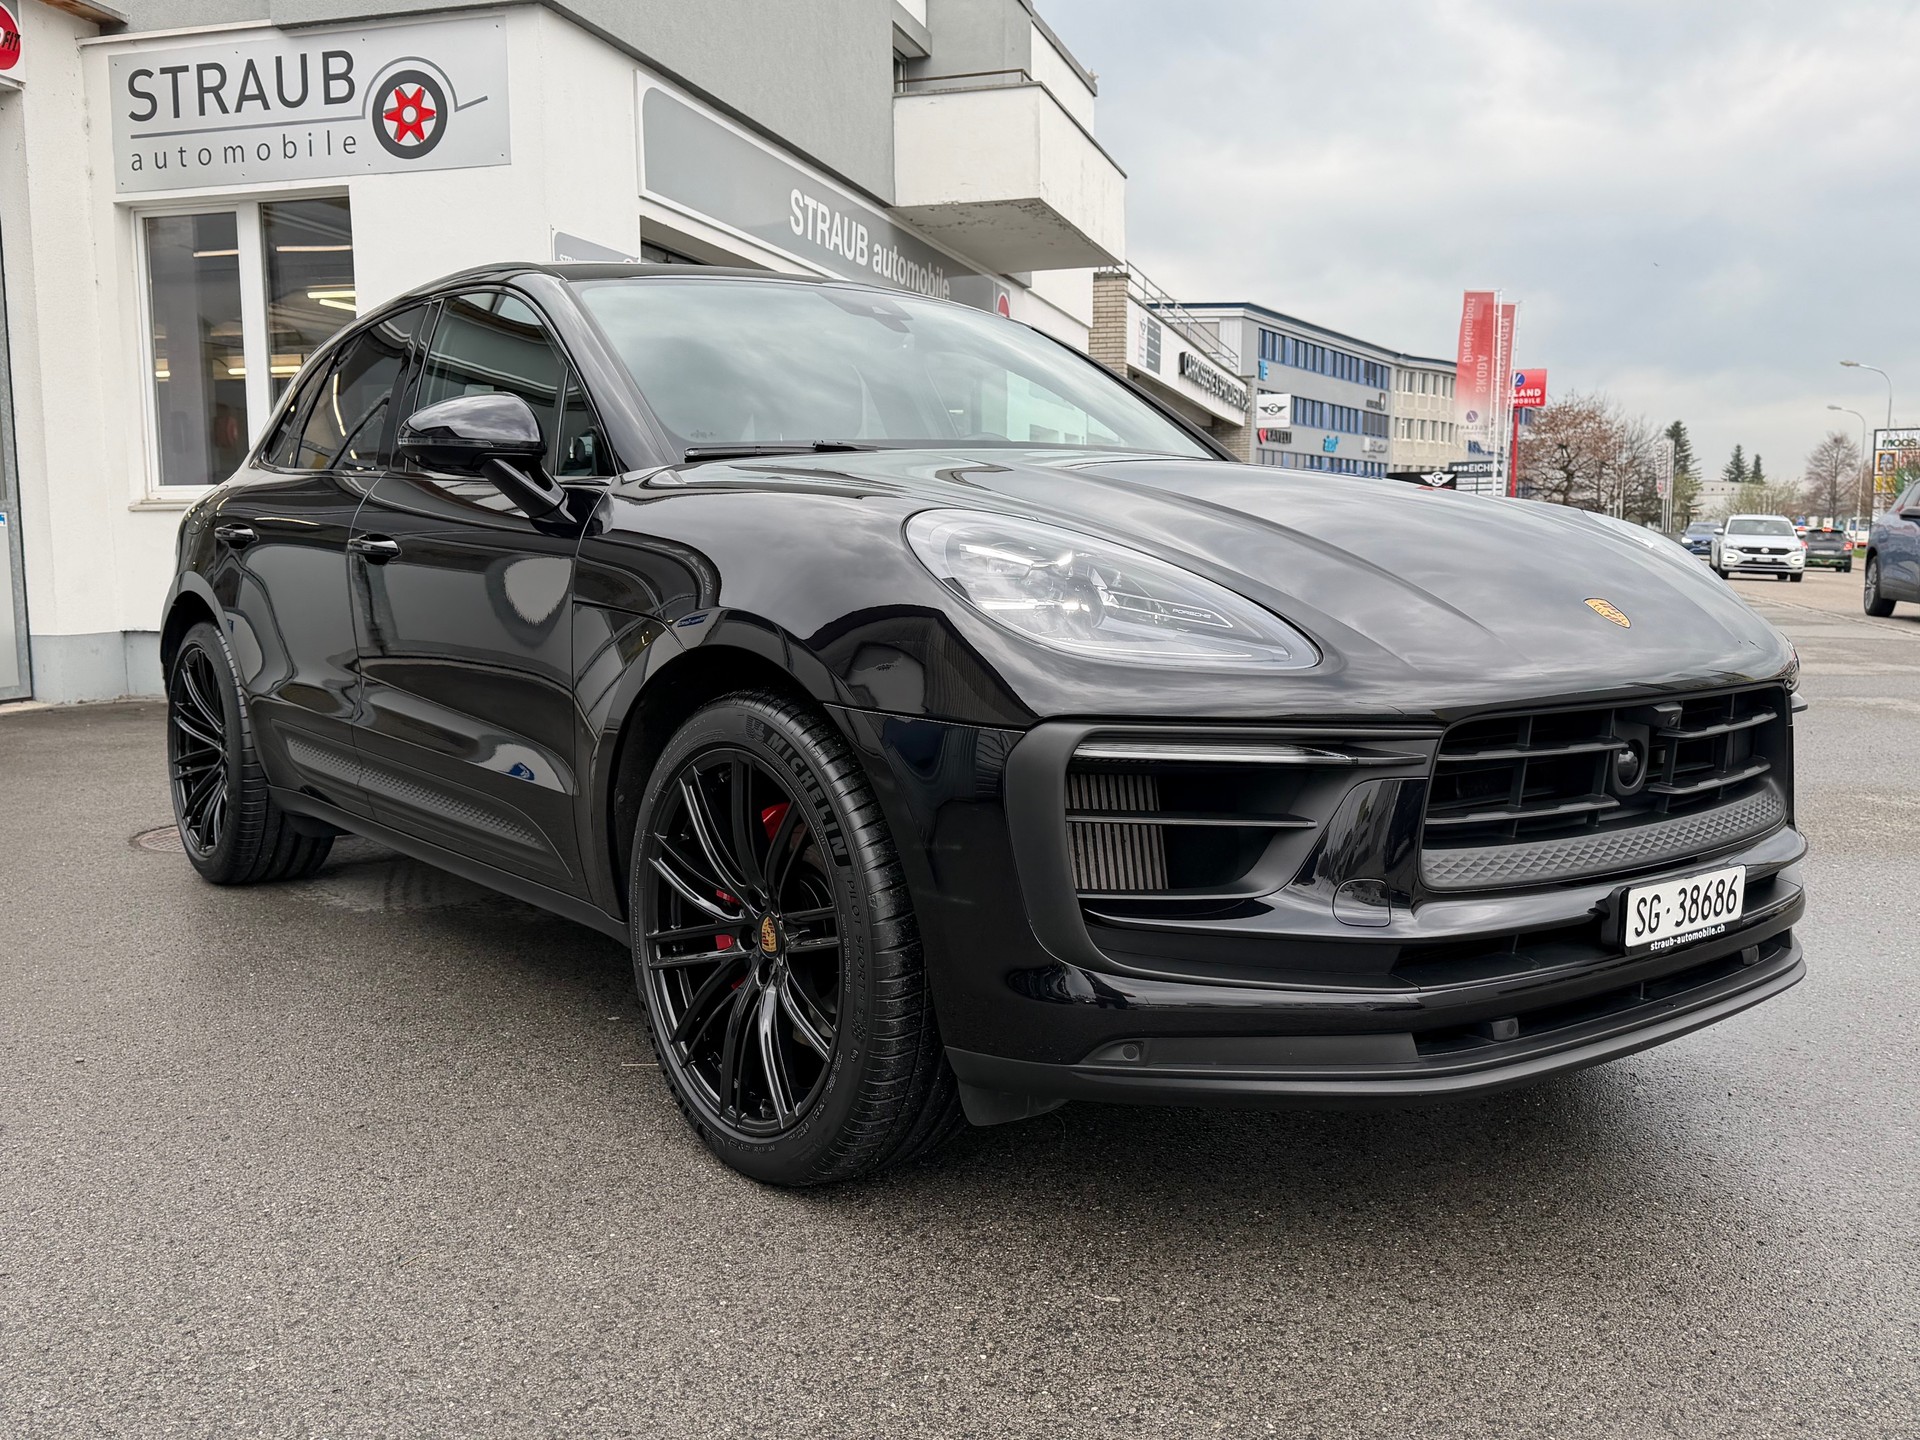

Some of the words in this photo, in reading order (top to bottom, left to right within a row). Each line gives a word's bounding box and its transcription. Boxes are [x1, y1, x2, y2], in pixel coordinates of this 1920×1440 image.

[128, 50, 356, 122] STRAUB
[131, 130, 357, 171] automobile
[790, 188, 869, 267] STRAUB
[872, 241, 951, 300] automobile
[1172, 608, 1211, 619] PORSCHE
[766, 732, 848, 857] MICHELIN
[847, 880, 862, 926] PILOT
[856, 935, 866, 995] SPORT
[1635, 894, 1661, 937] SG
[1675, 875, 1738, 927] 38686
[1650, 923, 1726, 951] straub-automobile.ch
